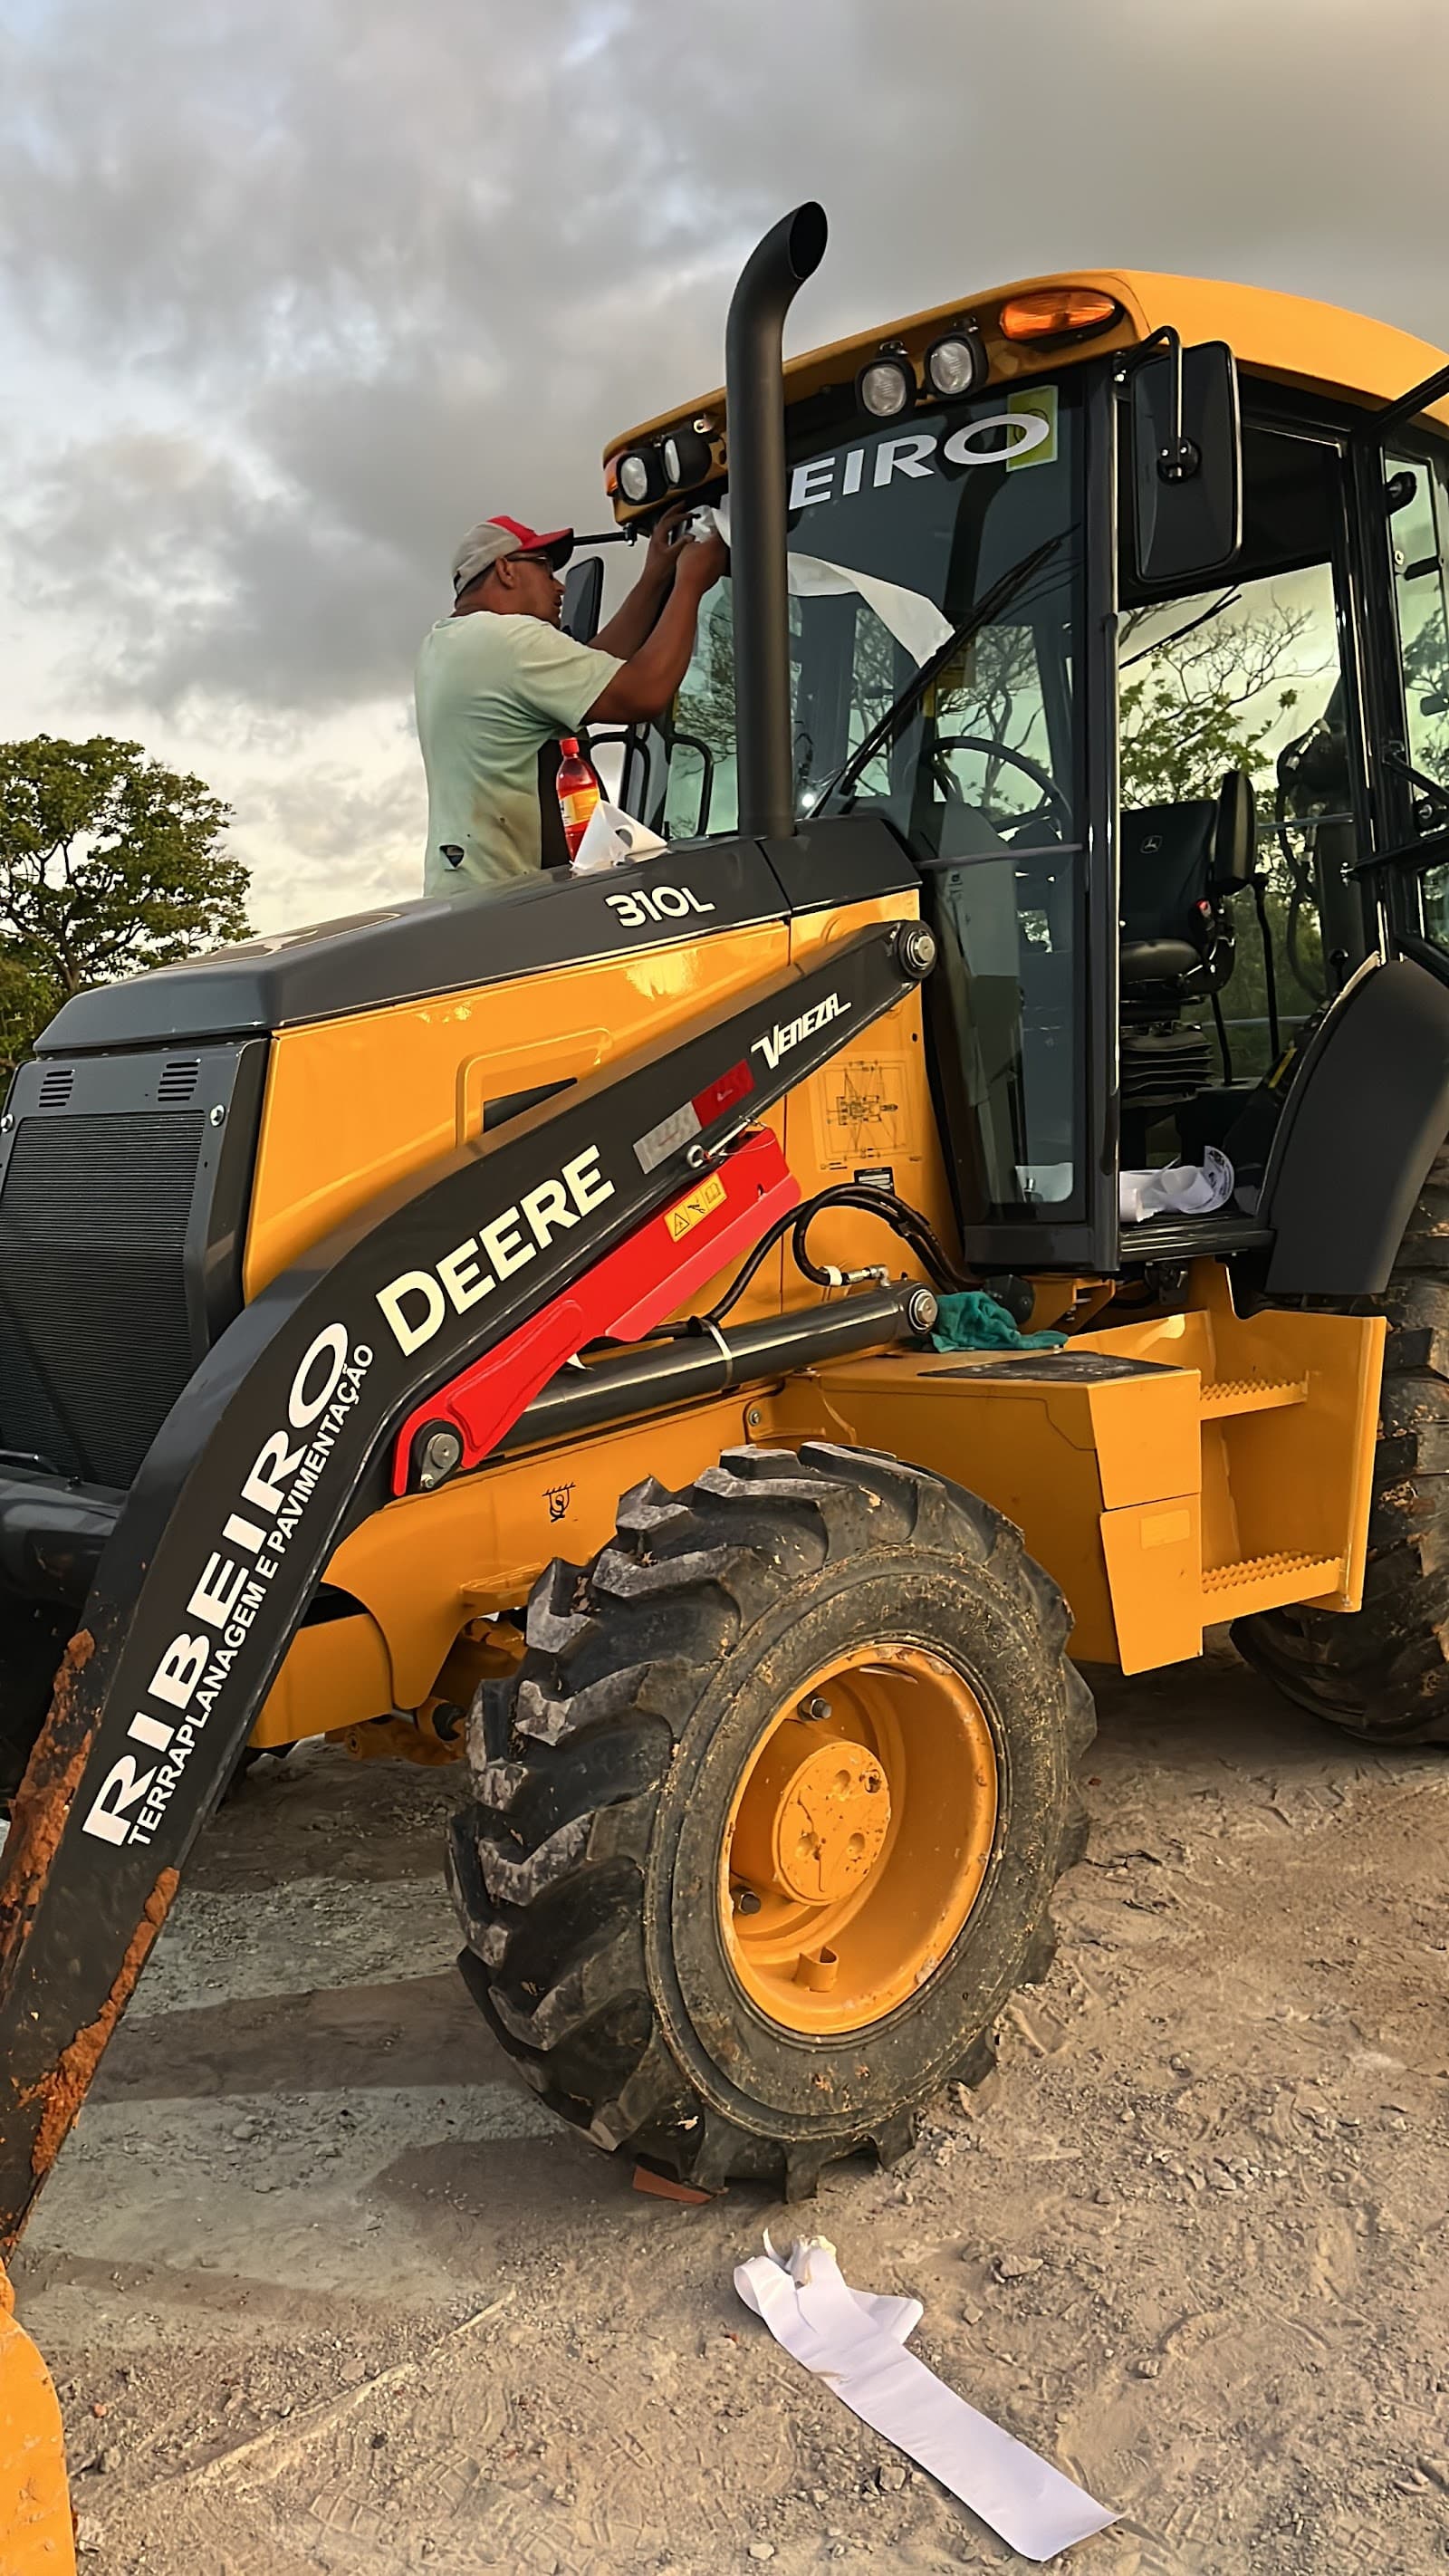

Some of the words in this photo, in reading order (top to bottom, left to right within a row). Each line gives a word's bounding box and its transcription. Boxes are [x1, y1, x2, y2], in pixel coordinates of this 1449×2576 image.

[789, 413, 1050, 511] EIRO
[605, 886, 715, 927] 310L
[750, 992, 852, 1070] VENEZA
[375, 1144, 616, 1357] DEERE
[266, 1343, 374, 1554] PAVIMENTAÇÃO
[82, 1322, 350, 1846] RIBEIRO
[254, 1554, 279, 1580] E
[127, 1581, 267, 1845] TERRAPLANAGEM
